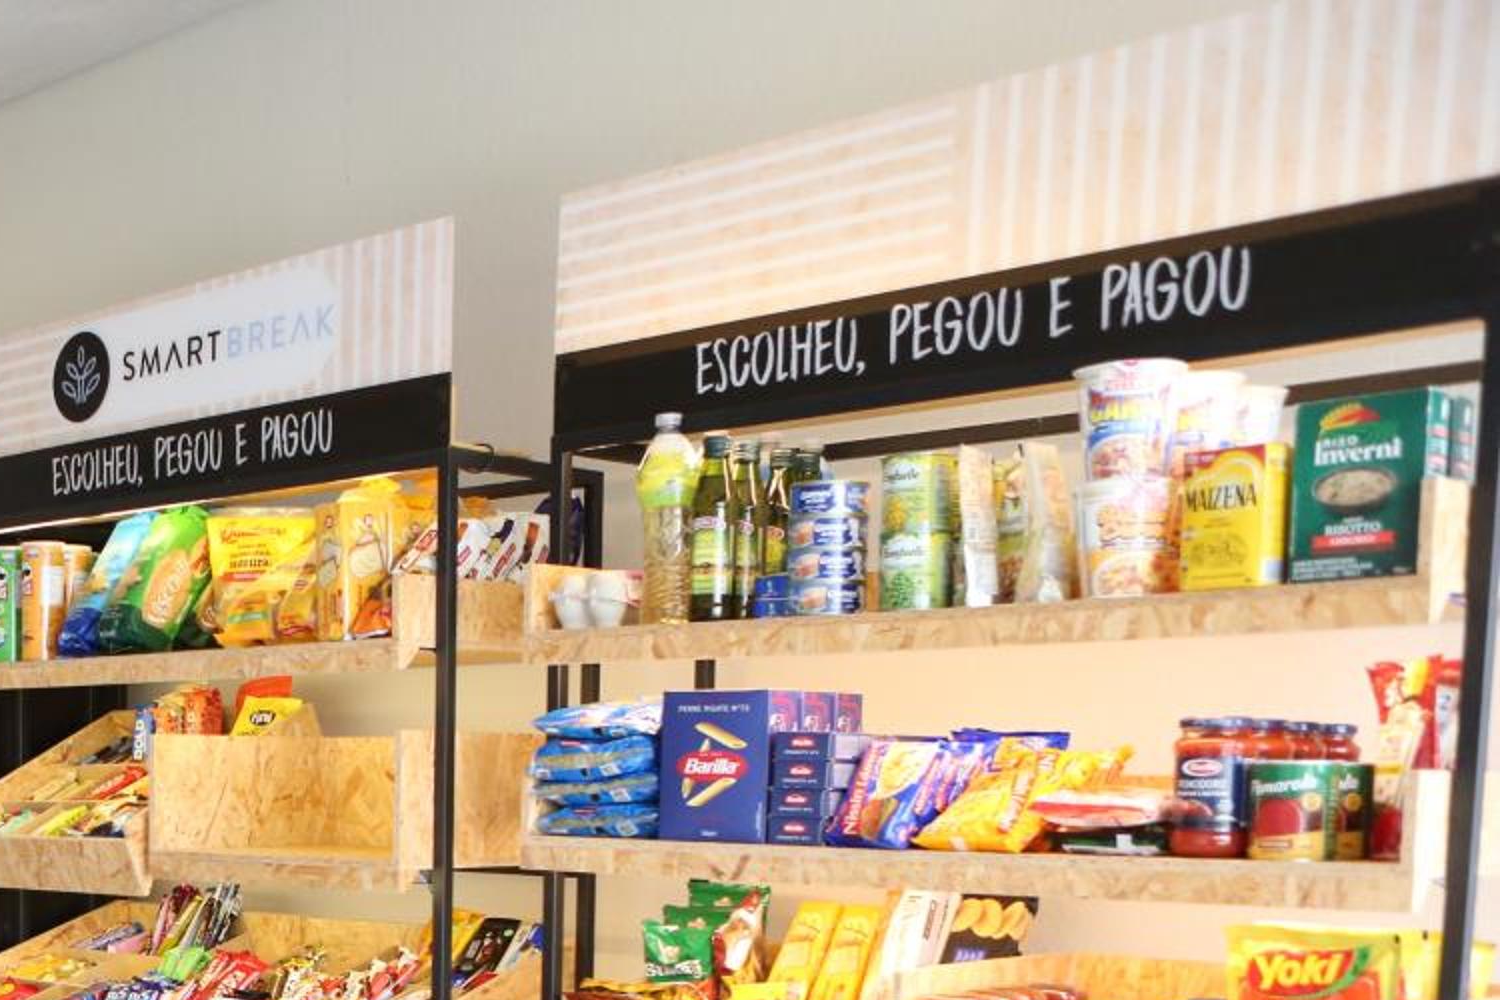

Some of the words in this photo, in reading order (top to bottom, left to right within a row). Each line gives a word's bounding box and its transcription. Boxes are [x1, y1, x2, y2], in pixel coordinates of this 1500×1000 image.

[122, 303, 336, 382] SMARTBREAK
[695, 317, 867, 397] ESCOLHEU,
[888, 286, 1023, 364] PEGOU
[1049, 276, 1072, 338] E
[1100, 245, 1252, 331] PAGOU
[51, 448, 144, 497] ESCOLHEU,
[154, 429, 224, 480] PEGOU
[234, 421, 248, 465] E
[260, 408, 335, 462] PAGOU
[1184, 482, 1258, 513] MAIZENA
[684, 756, 741, 775] Barilla
[1254, 951, 1343, 990] Yoki
